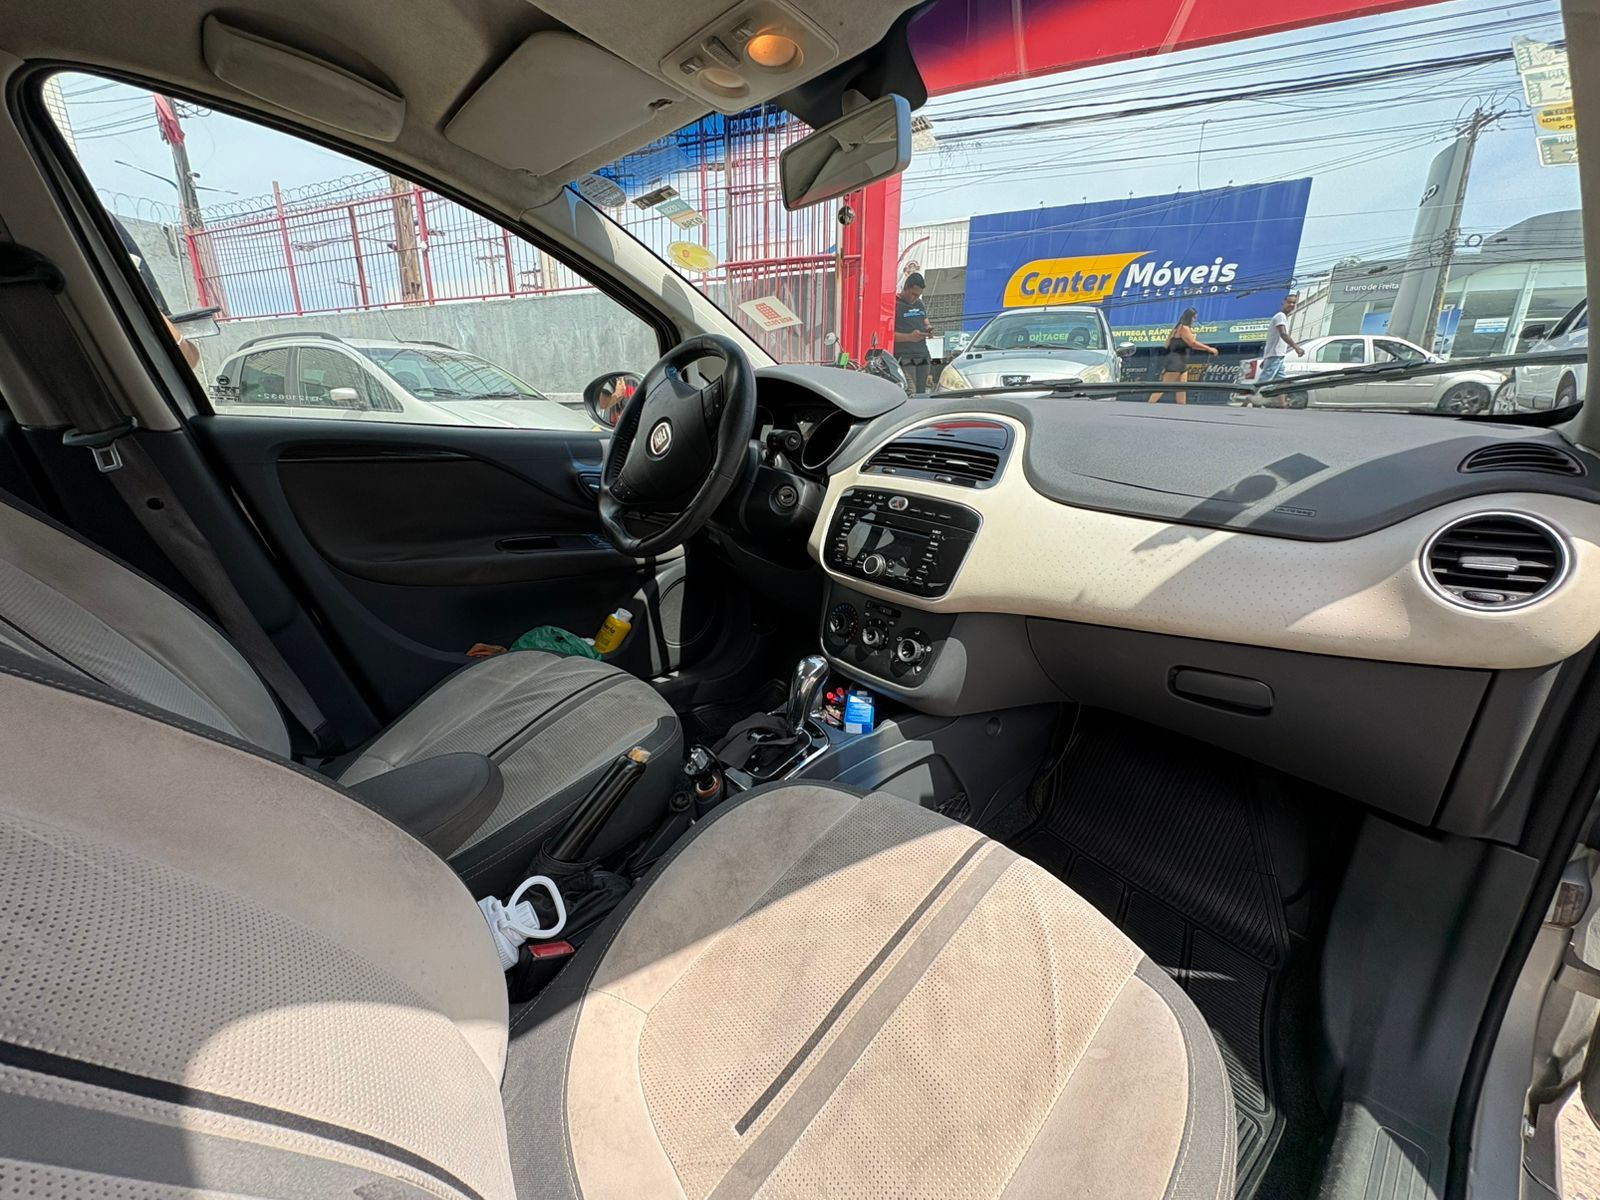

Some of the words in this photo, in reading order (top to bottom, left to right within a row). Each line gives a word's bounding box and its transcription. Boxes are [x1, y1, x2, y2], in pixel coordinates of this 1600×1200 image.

[1020, 271, 1114, 296] Center
[1124, 257, 1239, 288] Móveis
[1367, 283, 1377, 291] de
